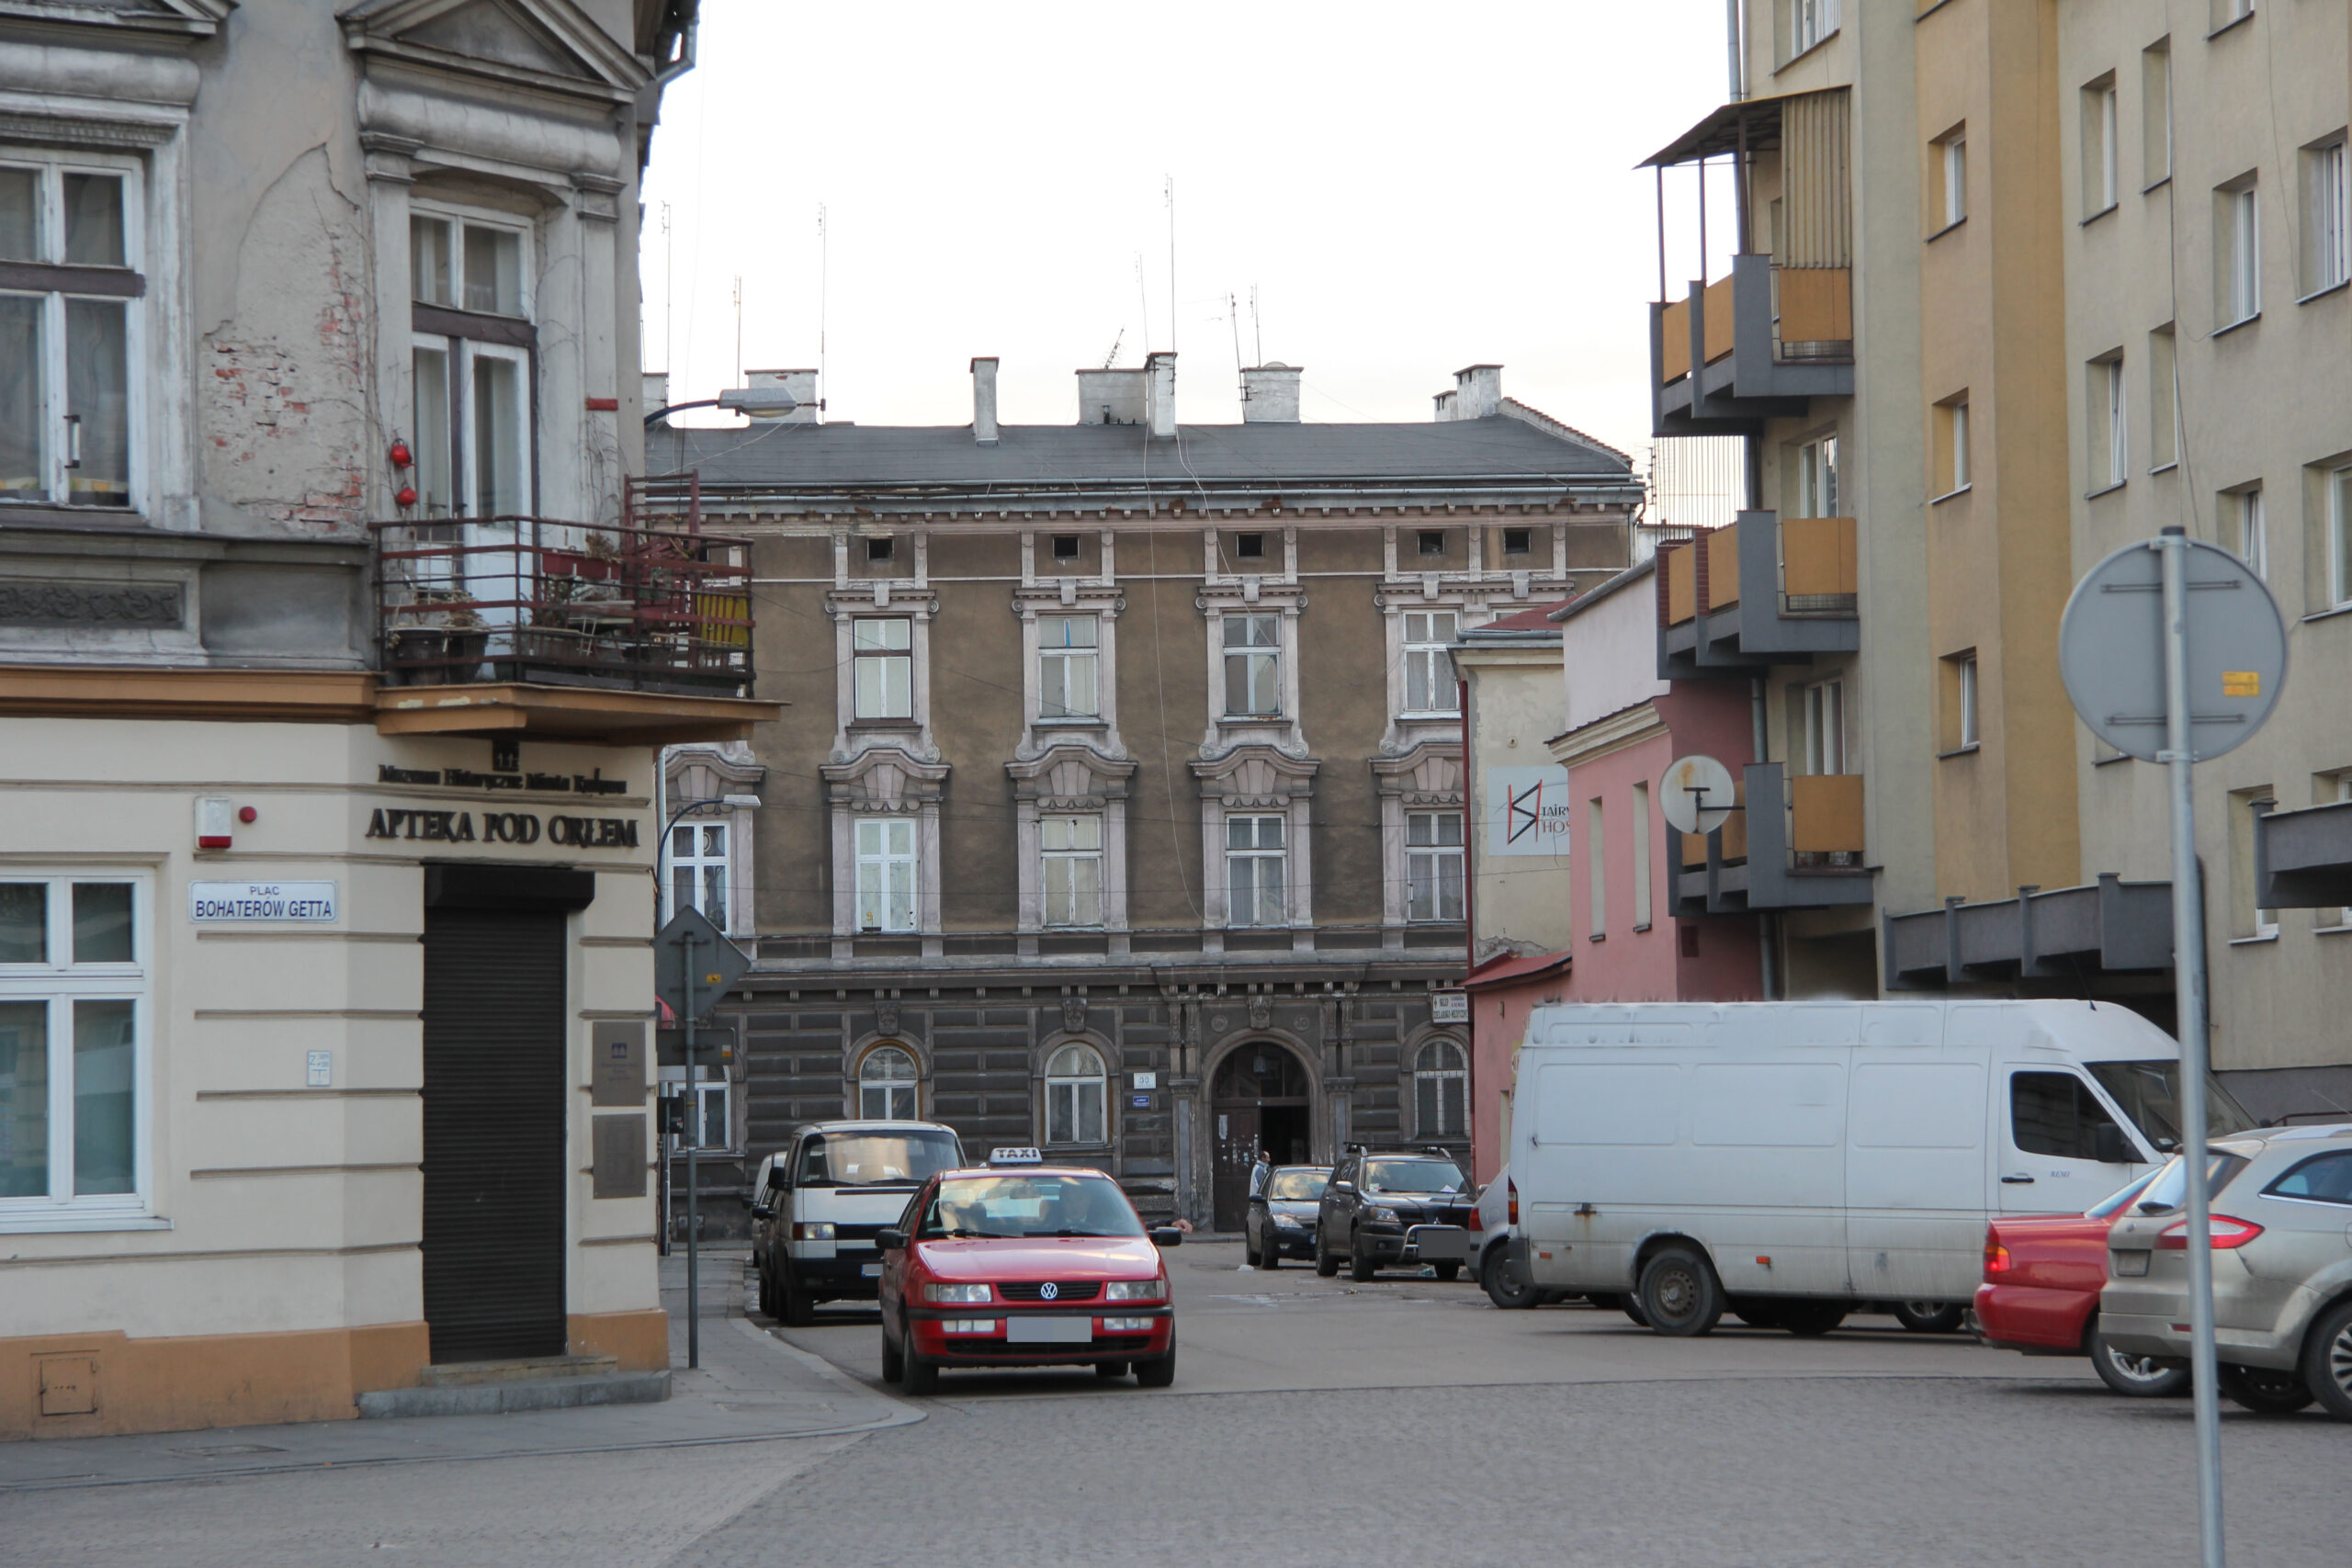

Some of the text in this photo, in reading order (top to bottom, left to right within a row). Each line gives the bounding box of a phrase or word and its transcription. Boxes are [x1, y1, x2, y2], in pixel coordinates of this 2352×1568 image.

[366, 808, 639, 848] APTEKA POD ORŁEM
[250, 886, 279, 896] PLAC
[196, 896, 332, 917] BOHATERÓW GETTA
[996, 1148, 1037, 1158] TAXI
